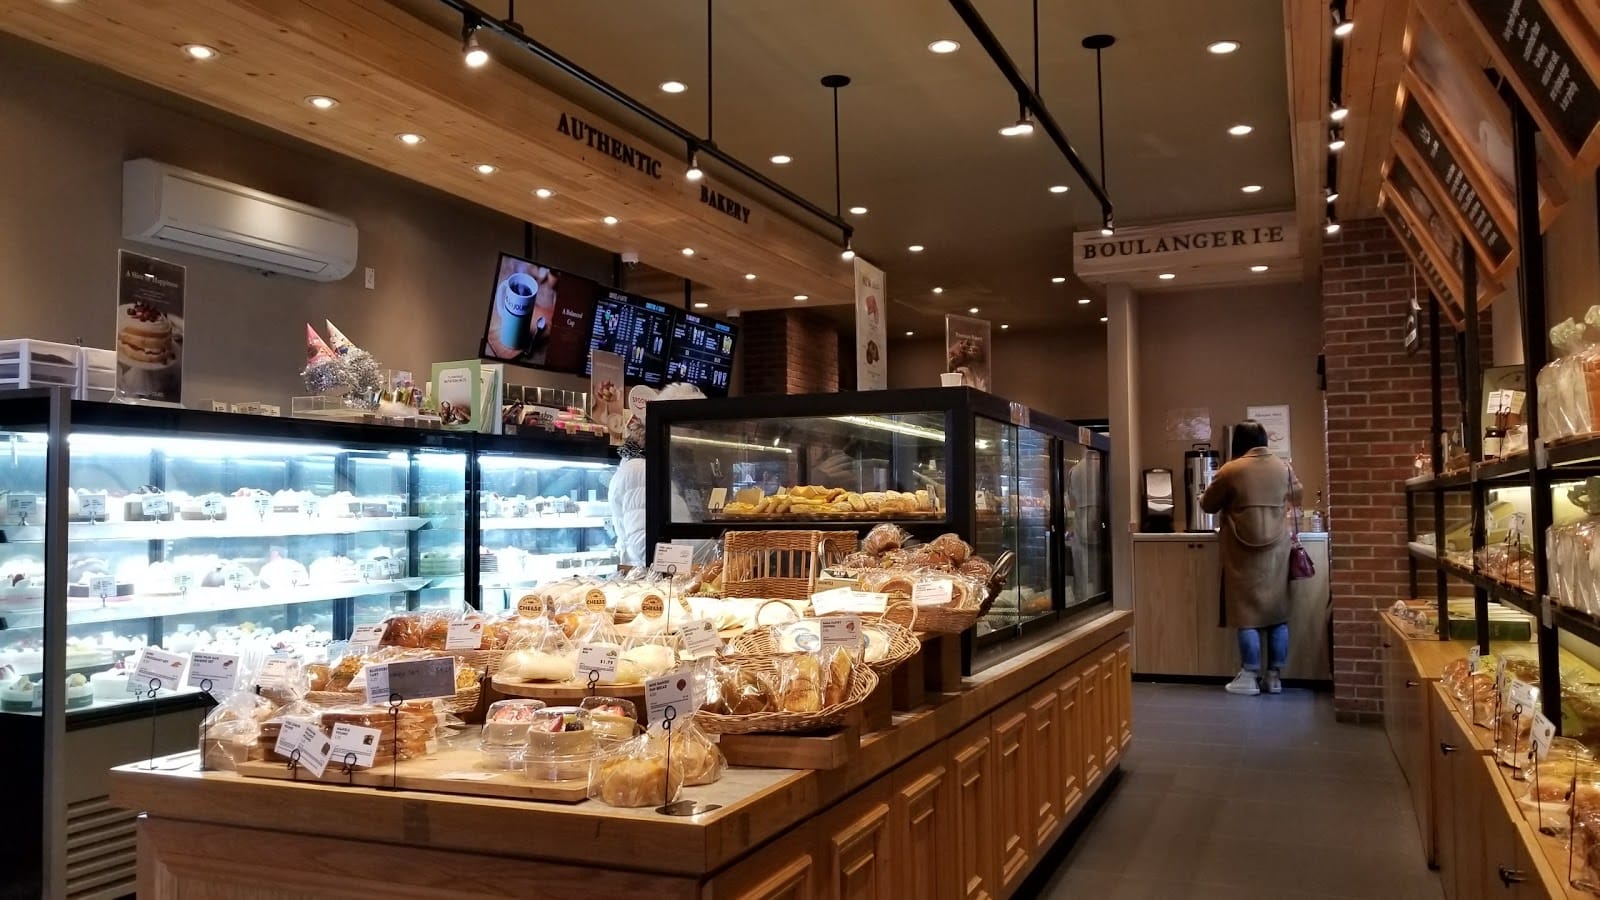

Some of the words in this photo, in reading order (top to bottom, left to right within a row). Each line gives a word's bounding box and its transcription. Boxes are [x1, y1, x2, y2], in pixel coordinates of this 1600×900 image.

[557, 112, 662, 180] AUTHENTIC
[700, 185, 751, 224] BAKERY
[1083, 226, 1284, 259] BOULANGERIE
